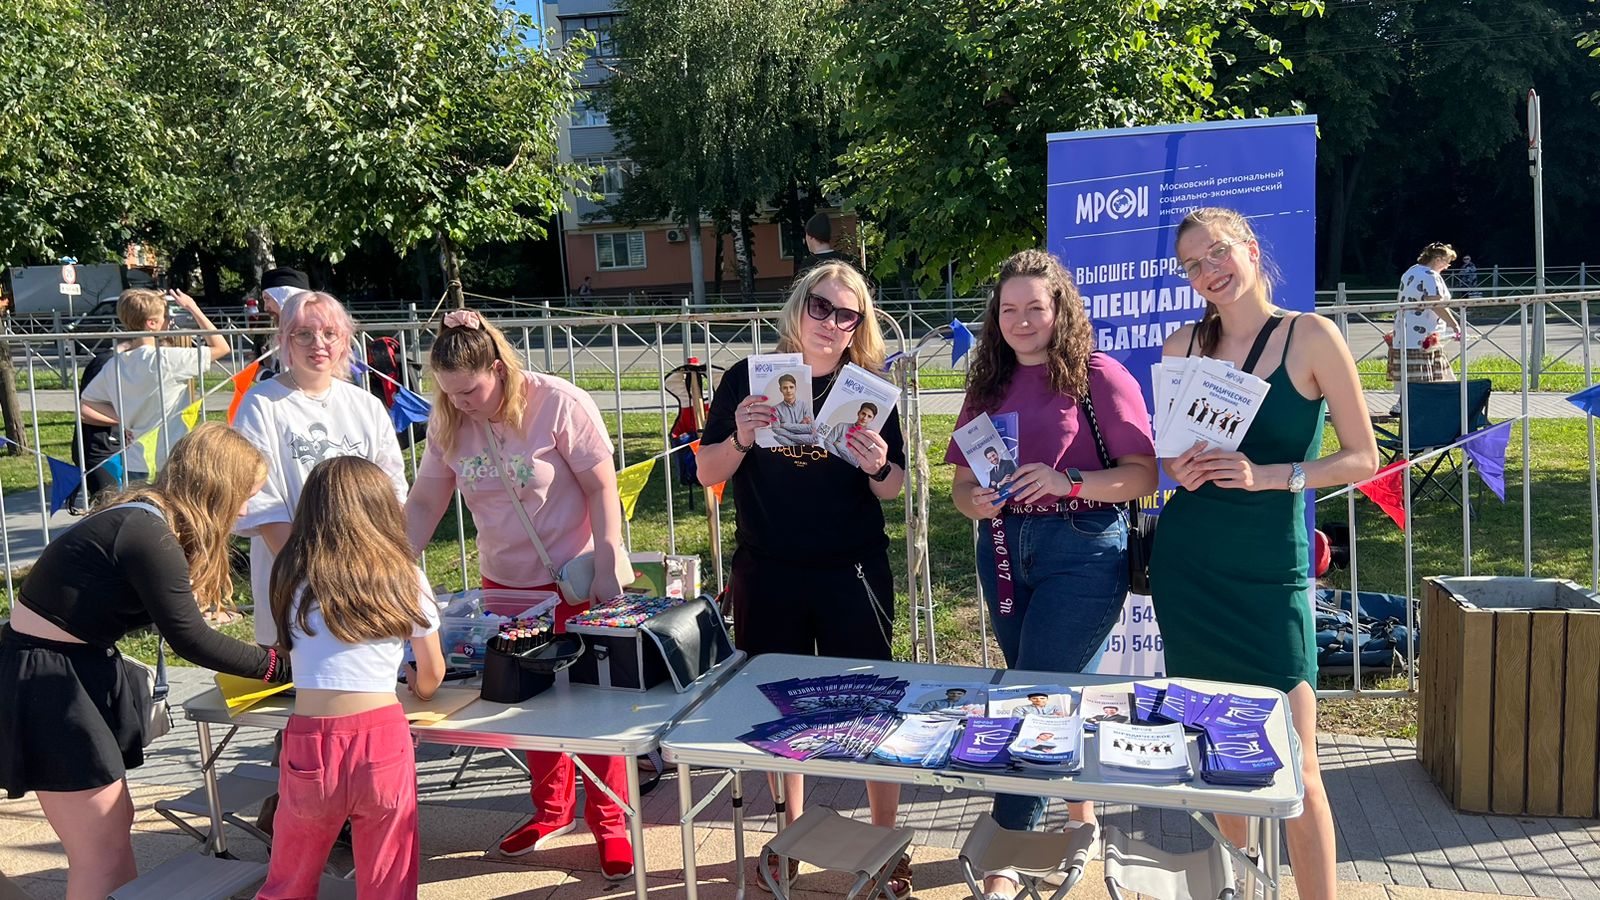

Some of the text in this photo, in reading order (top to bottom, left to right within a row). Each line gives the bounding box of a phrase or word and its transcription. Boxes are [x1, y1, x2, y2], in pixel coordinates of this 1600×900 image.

[1160, 168, 1284, 192] Московский региональный
[1160, 181, 1283, 204] социально-экономический
[1160, 205, 1198, 216] институт
[1076, 262, 1136, 285] ВЫСШЕЕ
[1202, 380, 1253, 406] ЮРИДИЧЕСКОЕ
[1132, 605, 1157, 624] 54
